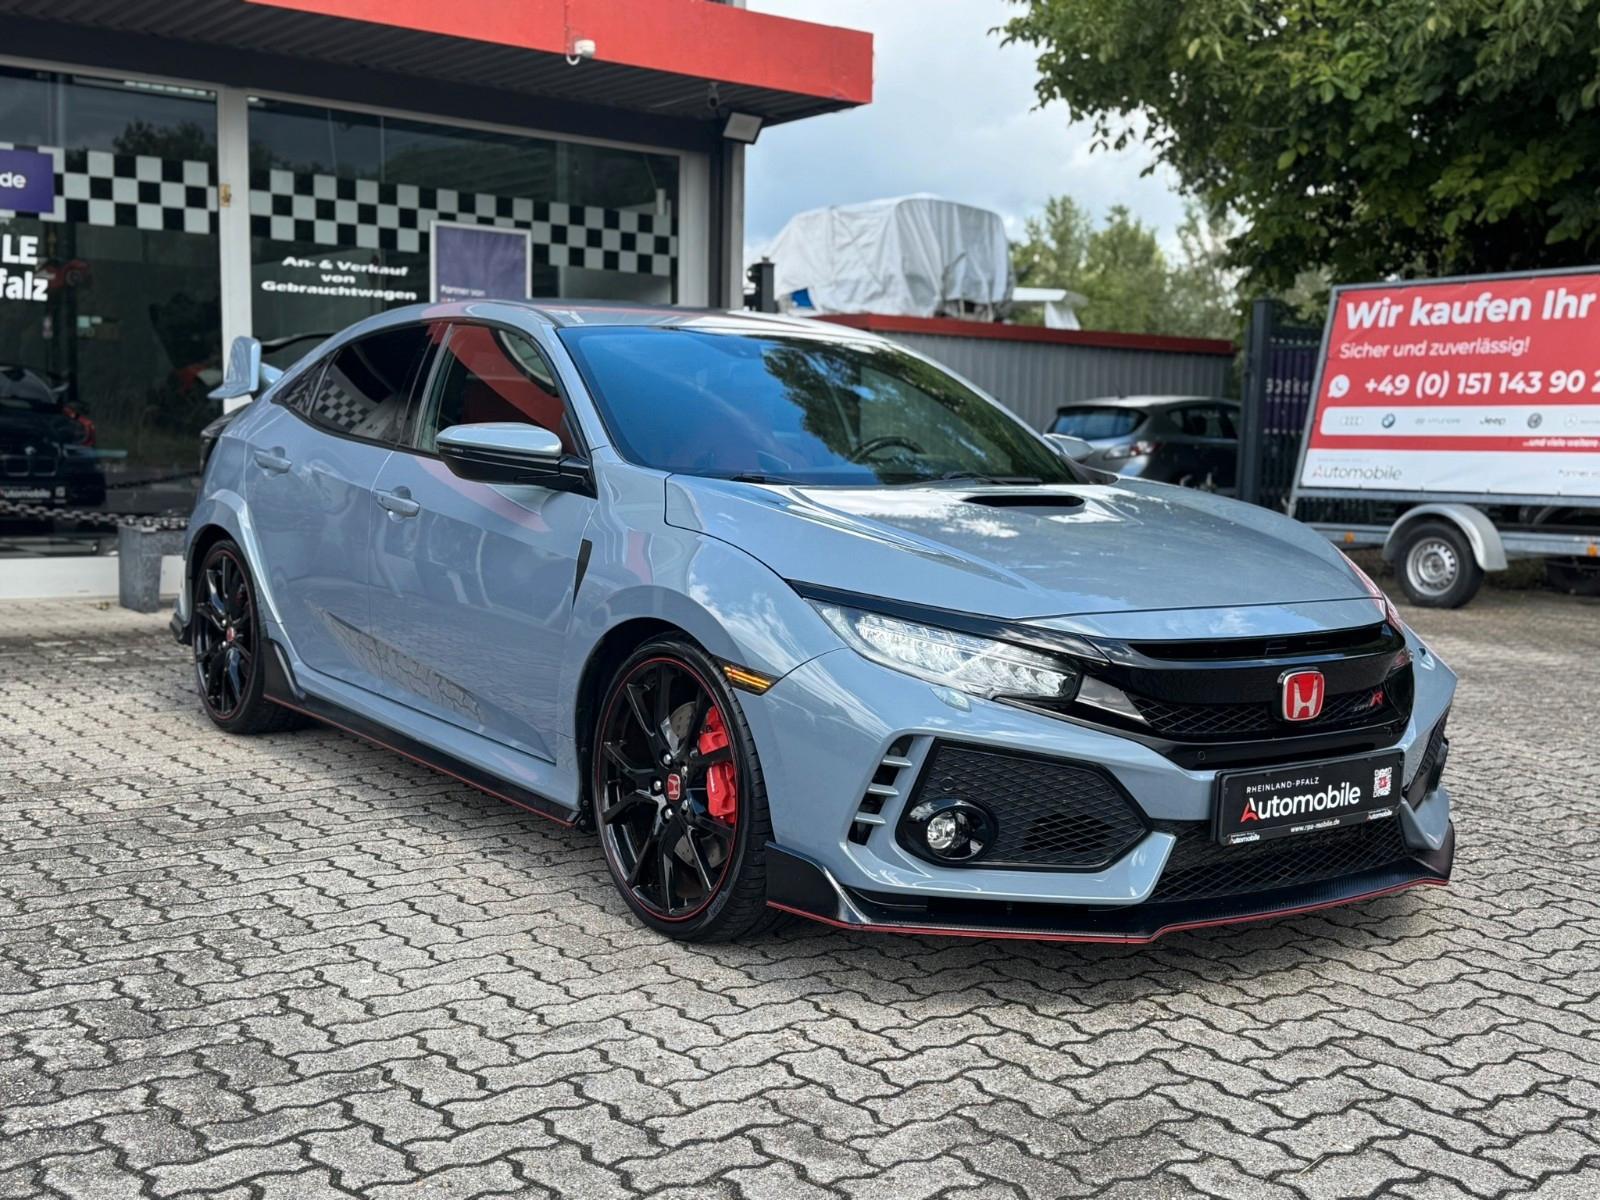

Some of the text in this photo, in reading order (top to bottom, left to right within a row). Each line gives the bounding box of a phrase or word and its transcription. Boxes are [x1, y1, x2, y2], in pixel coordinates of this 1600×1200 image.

[0, 172, 26, 188] de
[2, 233, 38, 265] LE
[282, 256, 409, 276] An- & Verkauf
[321, 274, 356, 284] von
[261, 280, 417, 301] Gebrauchtwagen
[1346, 287, 1597, 329] Wir kaufen Ihr
[1340, 336, 1531, 359] Sicher und zuverlässig!
[1365, 374, 1410, 396] +49
[1415, 370, 1449, 399] (0)
[1457, 372, 1492, 394] 151
[1499, 371, 1543, 394] 143
[1548, 369, 1586, 393] 90
[1312, 466, 1403, 481] Automobile
[1246, 776, 1320, 794] RHEINLAND-PFALZ
[1240, 781, 1361, 823] Automobile
